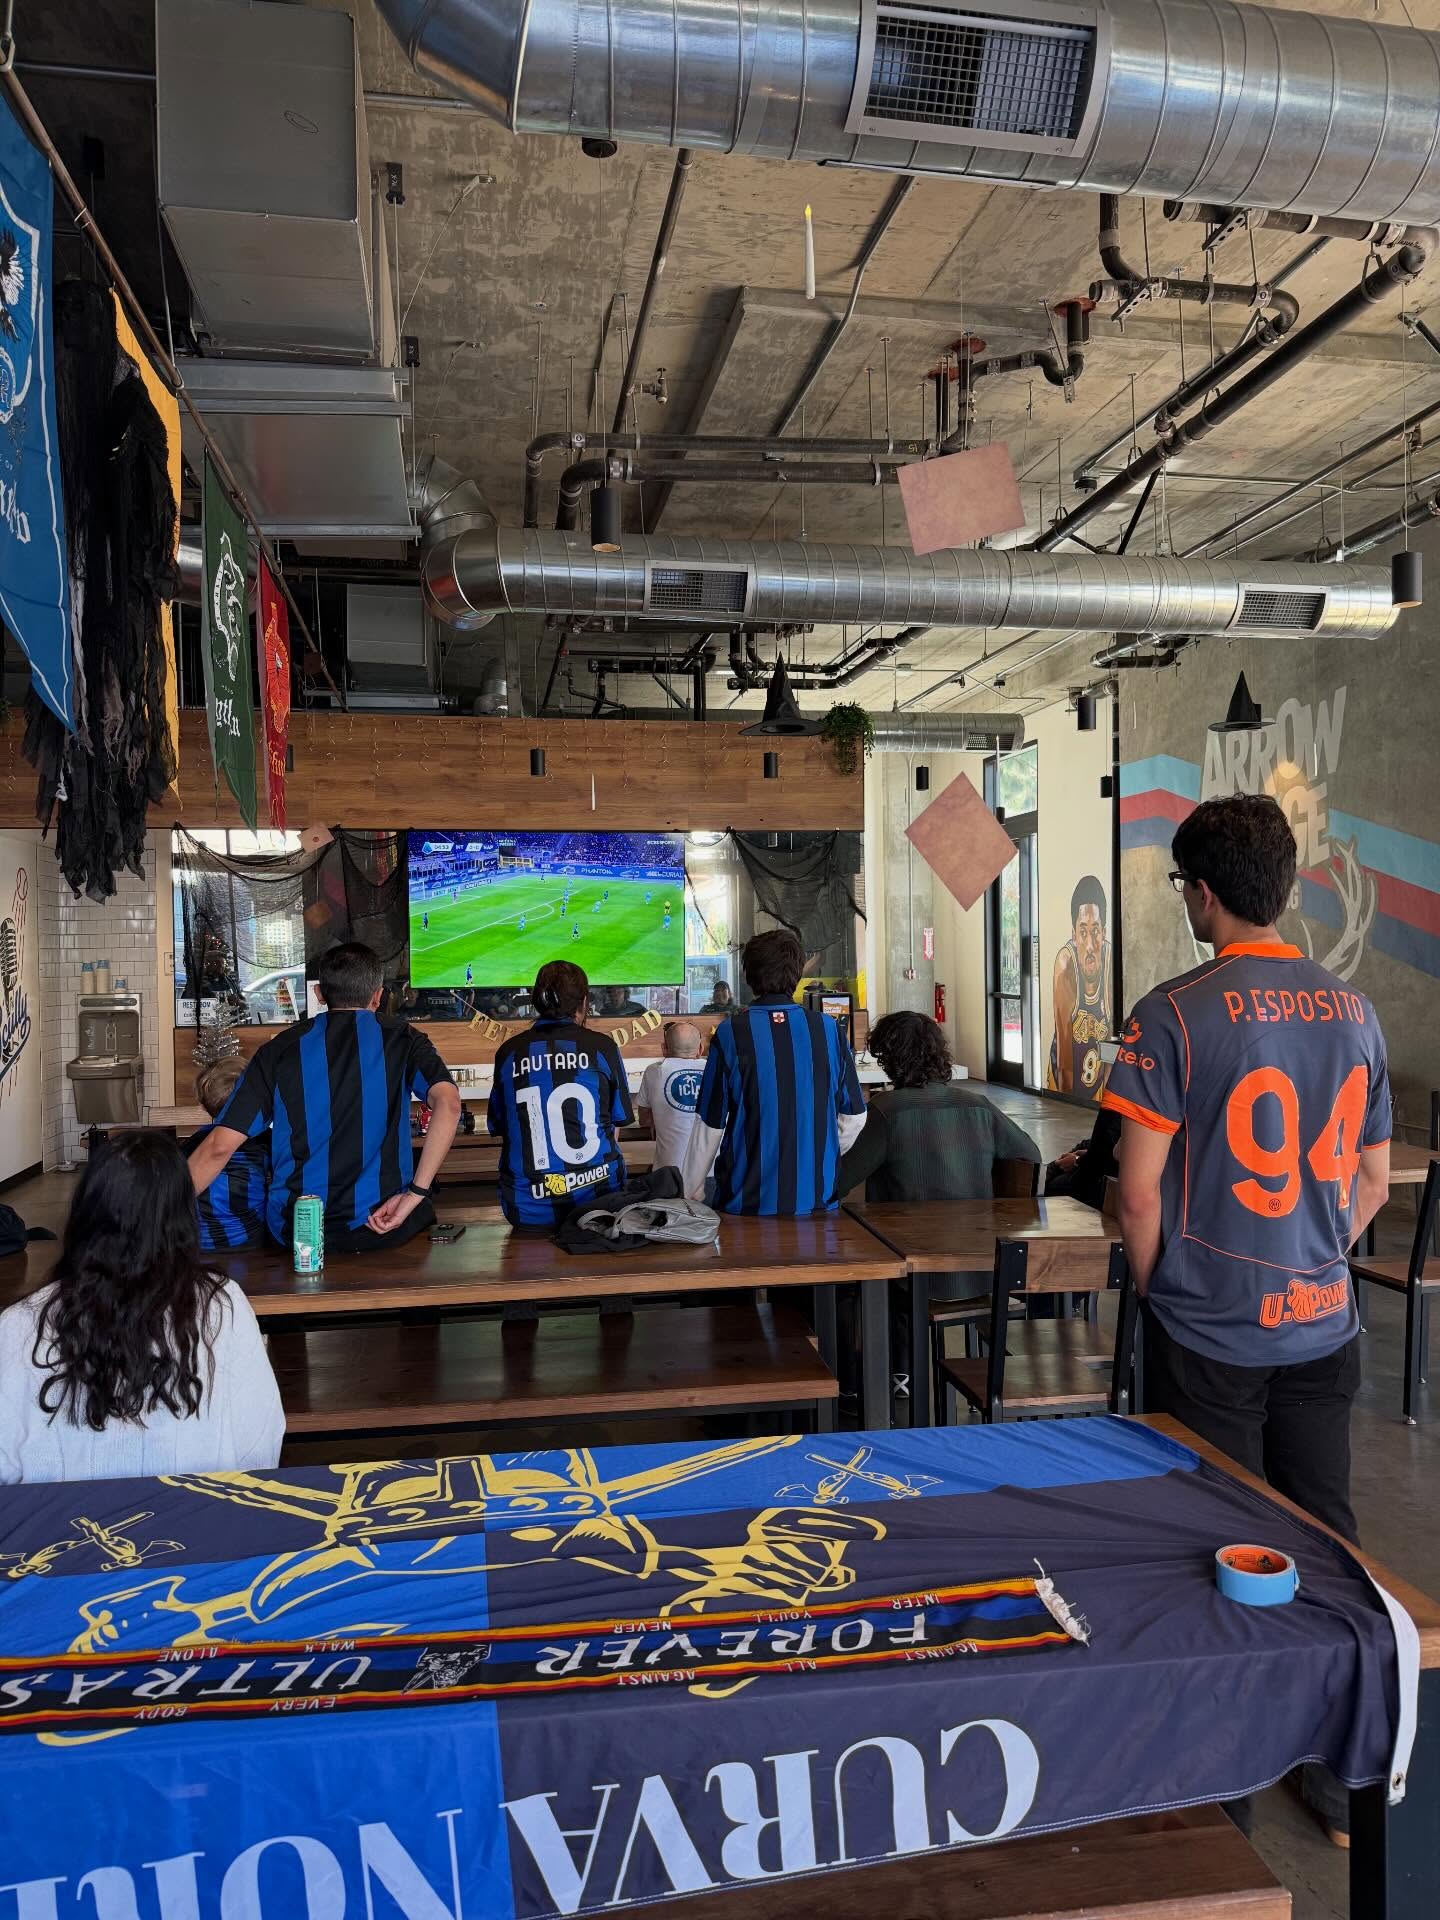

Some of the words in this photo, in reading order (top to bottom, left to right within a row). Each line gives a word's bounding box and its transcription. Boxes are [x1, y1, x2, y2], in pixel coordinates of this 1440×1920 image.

[1202, 686, 1347, 801] ARROW
[1224, 989, 1366, 1026] P.ESPOSITO
[512, 1052, 589, 1078] LAUTARO
[1081, 1048, 1100, 1087] 8
[516, 1083, 601, 1170] 10
[1227, 1065, 1369, 1217] 94
[892, 1593, 940, 1610] INTER
[752, 1611, 812, 1623] YOU'LL
[613, 1620, 672, 1634] NEVER
[305, 1640, 356, 1653] WALK
[536, 1612, 929, 1676] FOREVER
[904, 1643, 979, 1662] AGAINST
[158, 1647, 219, 1662] ALONE
[784, 1659, 817, 1673] ALL
[0, 1655, 372, 1709] ULTRAS
[617, 1669, 696, 1686] AGAINST
[134, 1706, 188, 1719] BODY
[269, 1696, 336, 1712] EVERY
[499, 1718, 1040, 1915] CURVA
